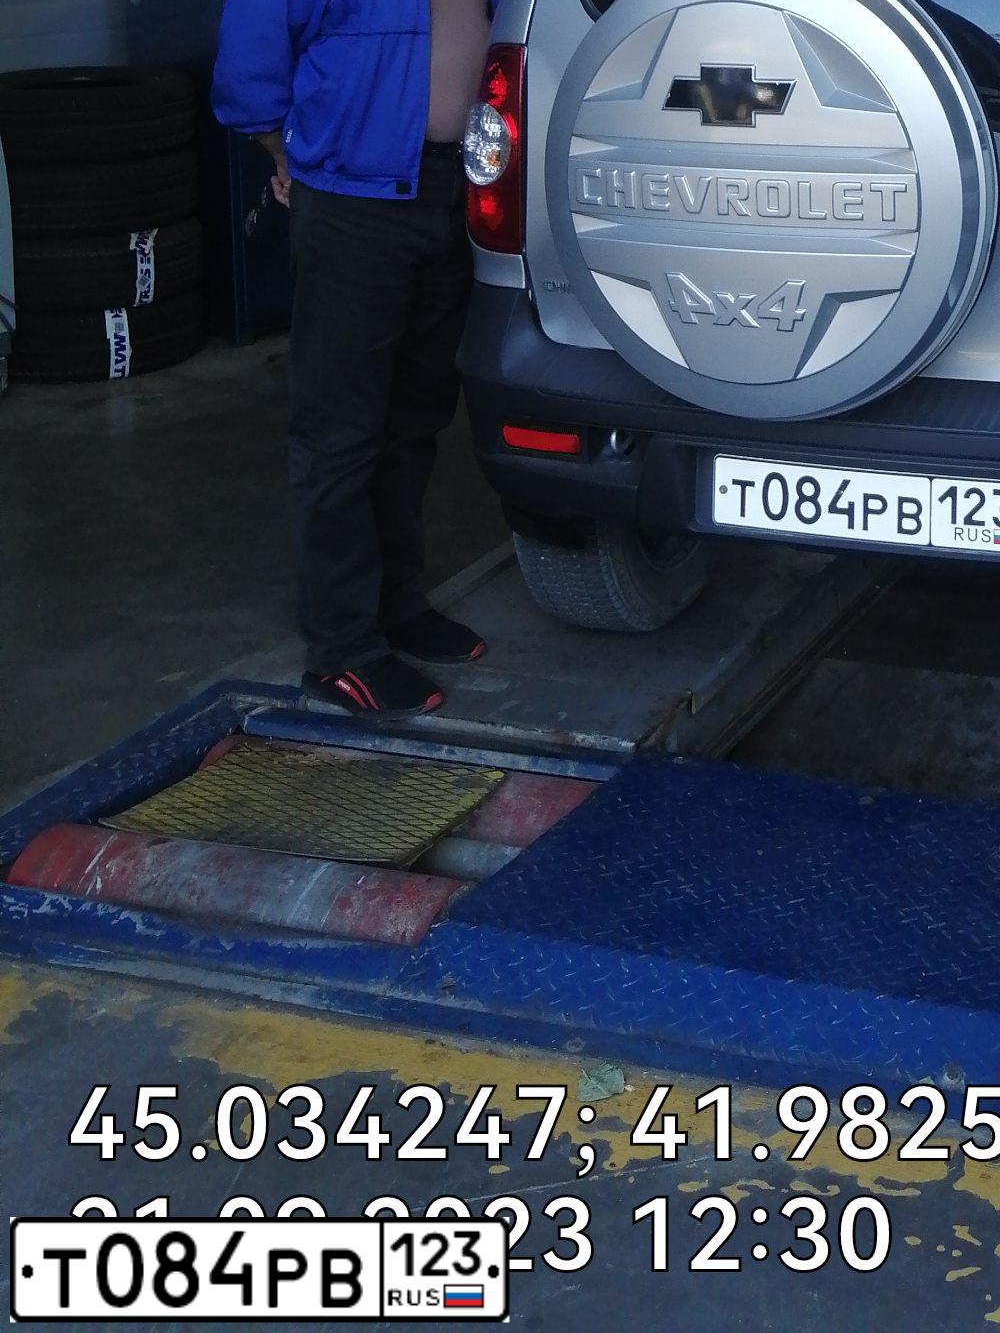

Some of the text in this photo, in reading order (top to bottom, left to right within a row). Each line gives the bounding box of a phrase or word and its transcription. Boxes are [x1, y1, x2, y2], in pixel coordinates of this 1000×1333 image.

[575, 167, 908, 222] CHEVROLET
[731, 471, 924, 536] Т084РВ
[953, 527, 992, 544] RUS
